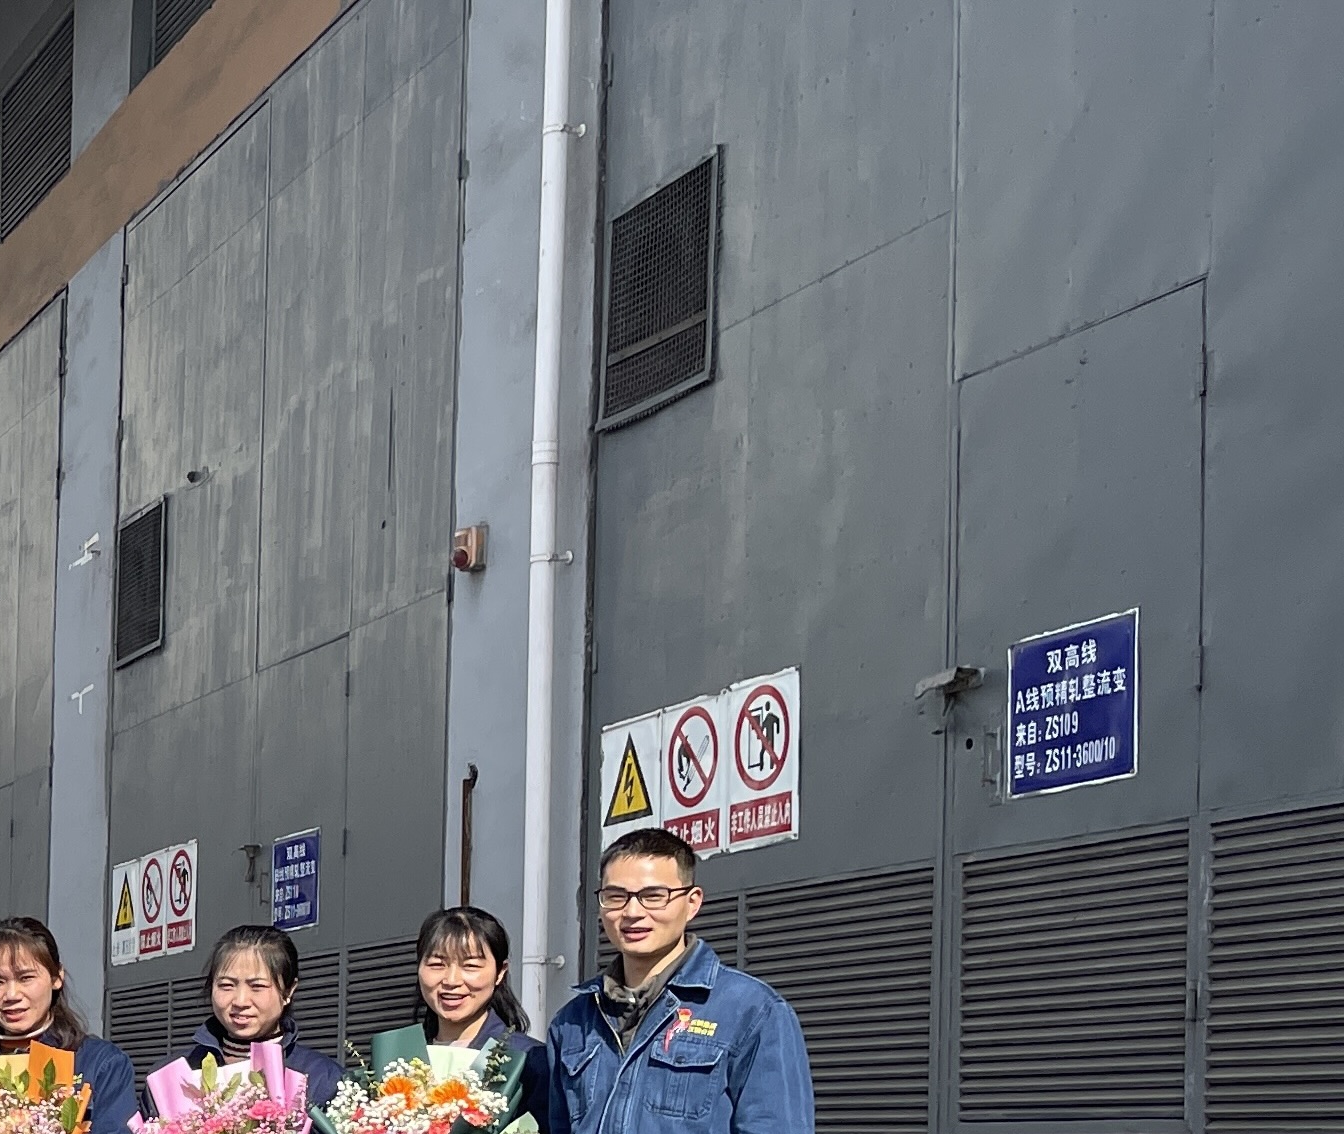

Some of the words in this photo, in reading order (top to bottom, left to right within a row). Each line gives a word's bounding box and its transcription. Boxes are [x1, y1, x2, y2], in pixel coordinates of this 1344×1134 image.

[1046, 638, 1097, 674] 双高线
[1015, 666, 1127, 714] A线预精轧整流变
